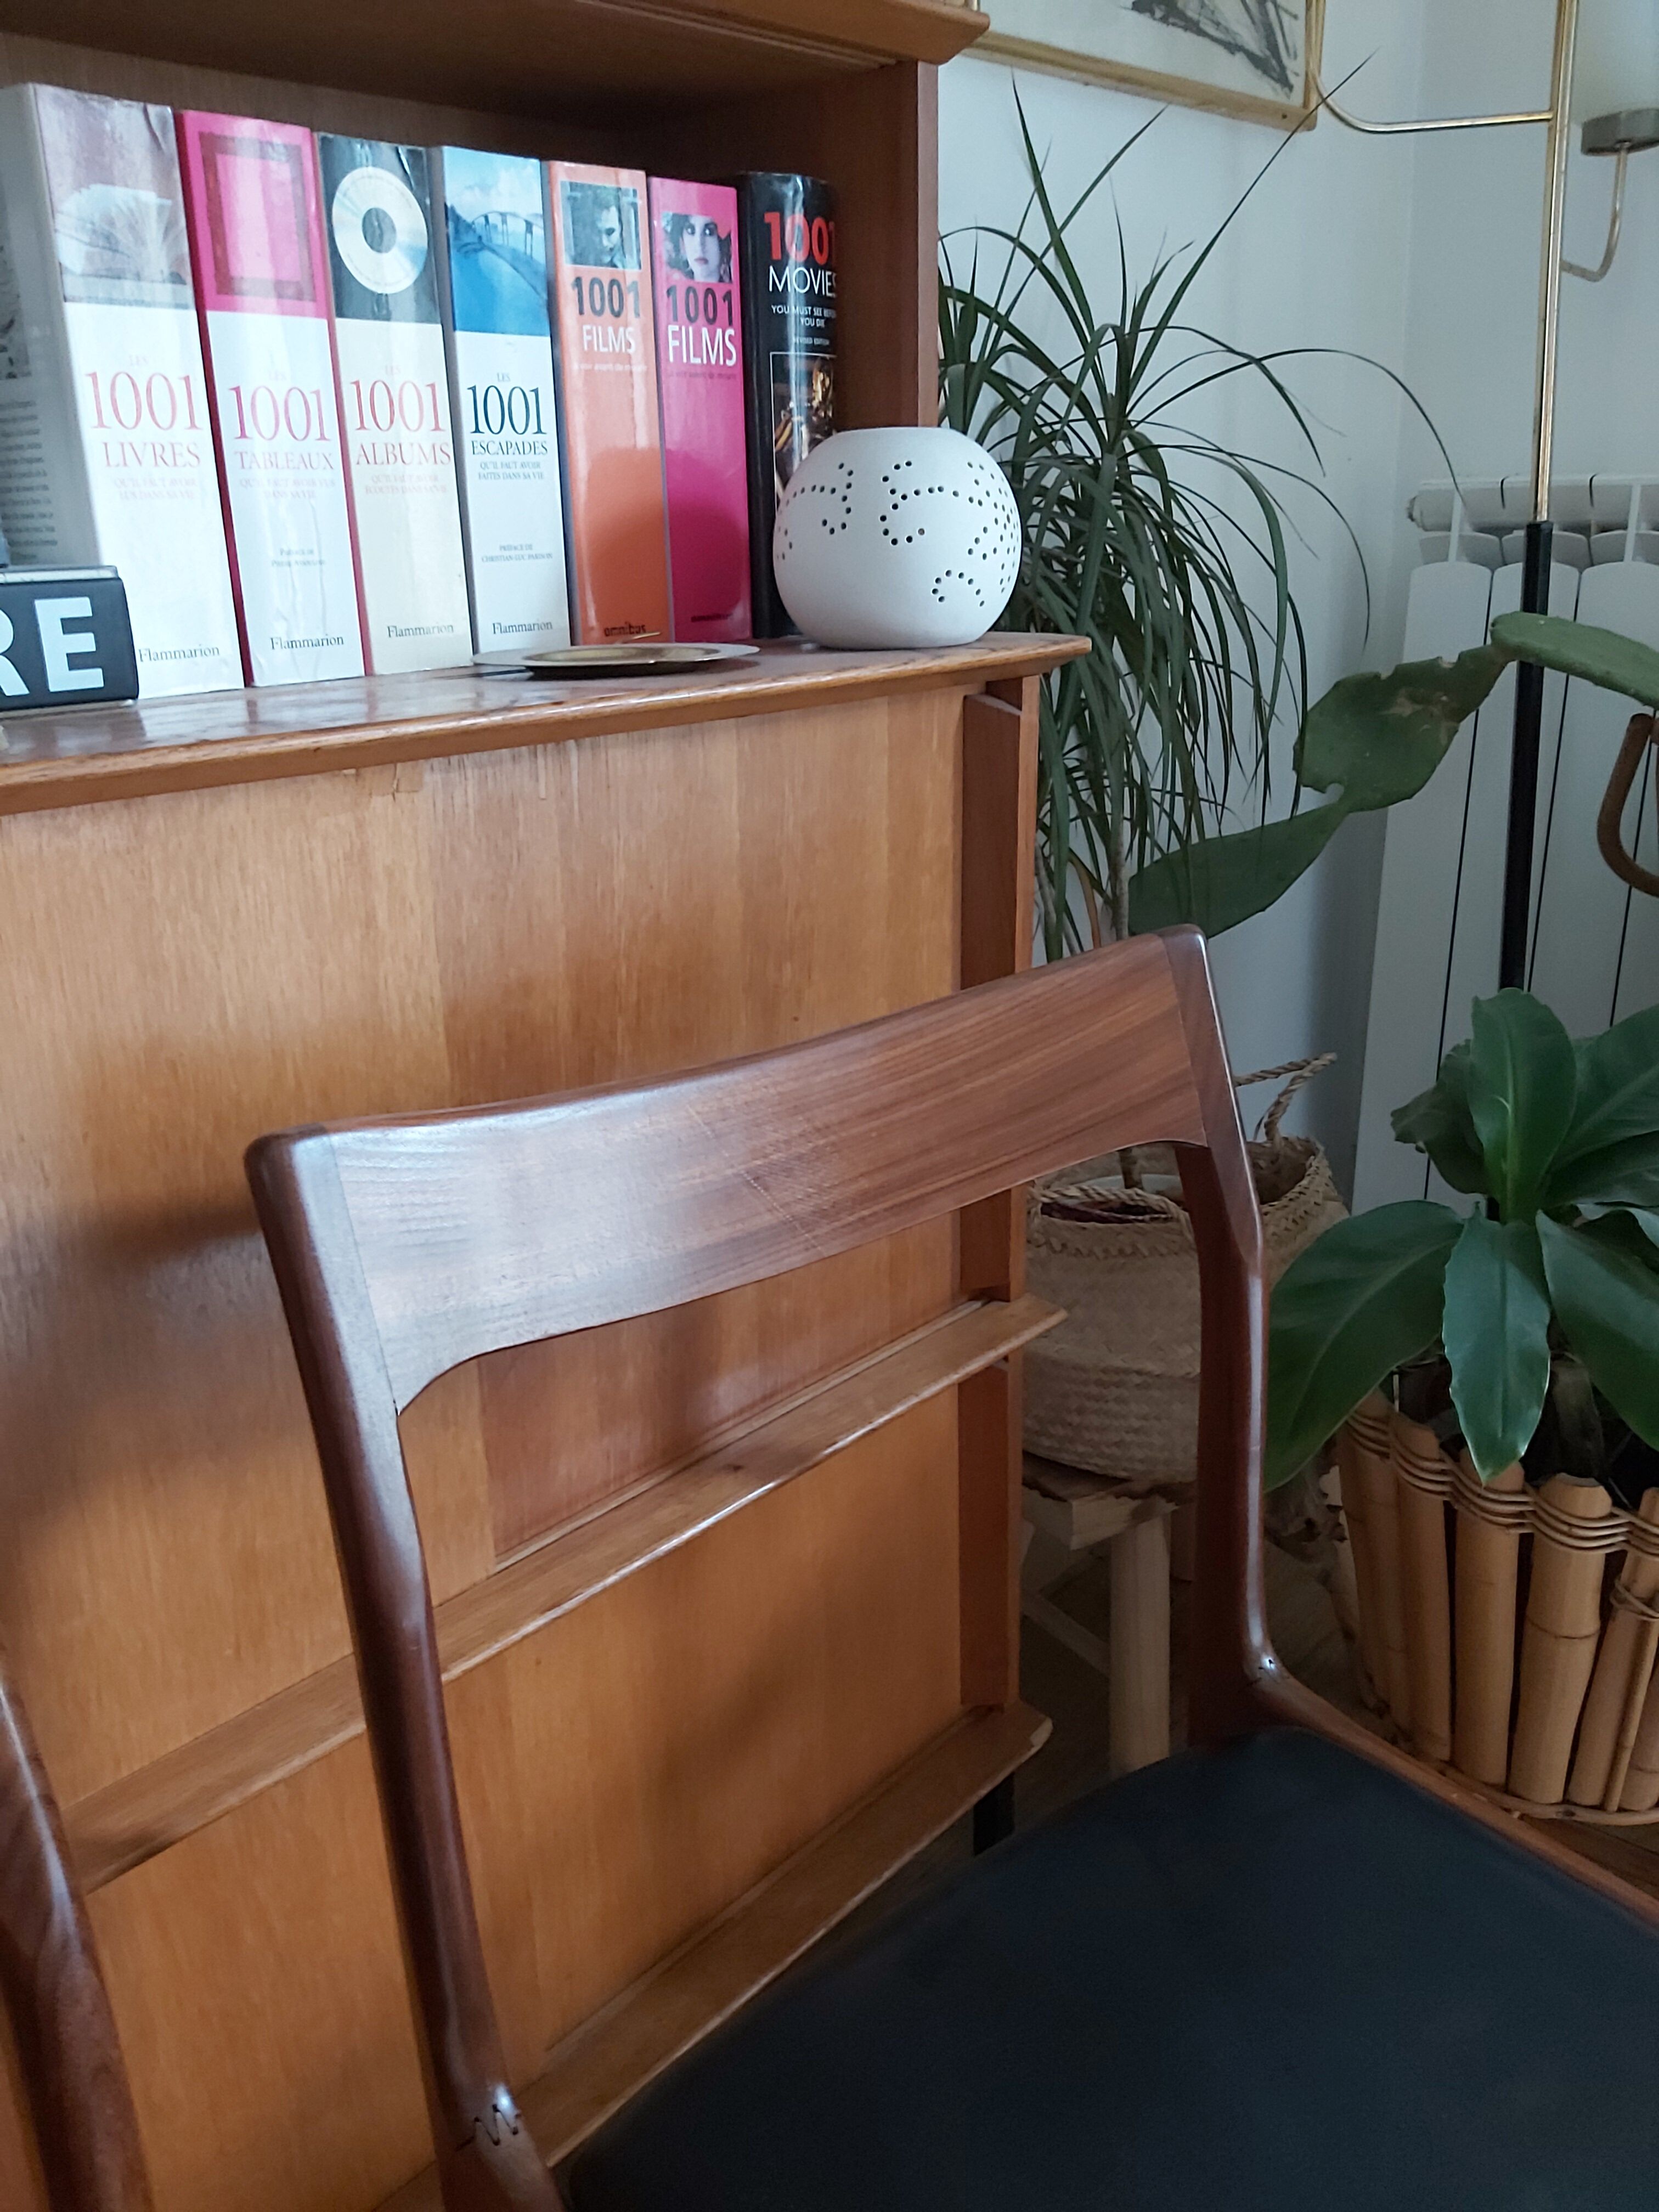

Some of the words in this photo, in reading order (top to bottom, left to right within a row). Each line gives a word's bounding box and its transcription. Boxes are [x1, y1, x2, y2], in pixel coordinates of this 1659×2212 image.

[571, 276, 641, 319] 1001
[667, 285, 733, 327] 1001
[771, 304, 789, 314] YOU
[800, 317, 815, 327] YOU
[583, 324, 636, 354] FILMS
[668, 324, 737, 367] FILMS
[497, 373, 511, 382] LES
[84, 371, 204, 431] 1001
[350, 379, 446, 432] 1001
[466, 385, 548, 435] 1001
[228, 385, 331, 442] 1001
[102, 441, 201, 468] LIVRES
[356, 442, 452, 466] ALBUMS
[471, 440, 548, 455] ESCAPADES
[233, 451, 334, 471] TABLEAUX
[387, 622, 454, 638] Flammarion
[492, 619, 553, 635] Flammarion
[270, 633, 345, 650] Flammarion
[139, 645, 221, 663] Flammarion
